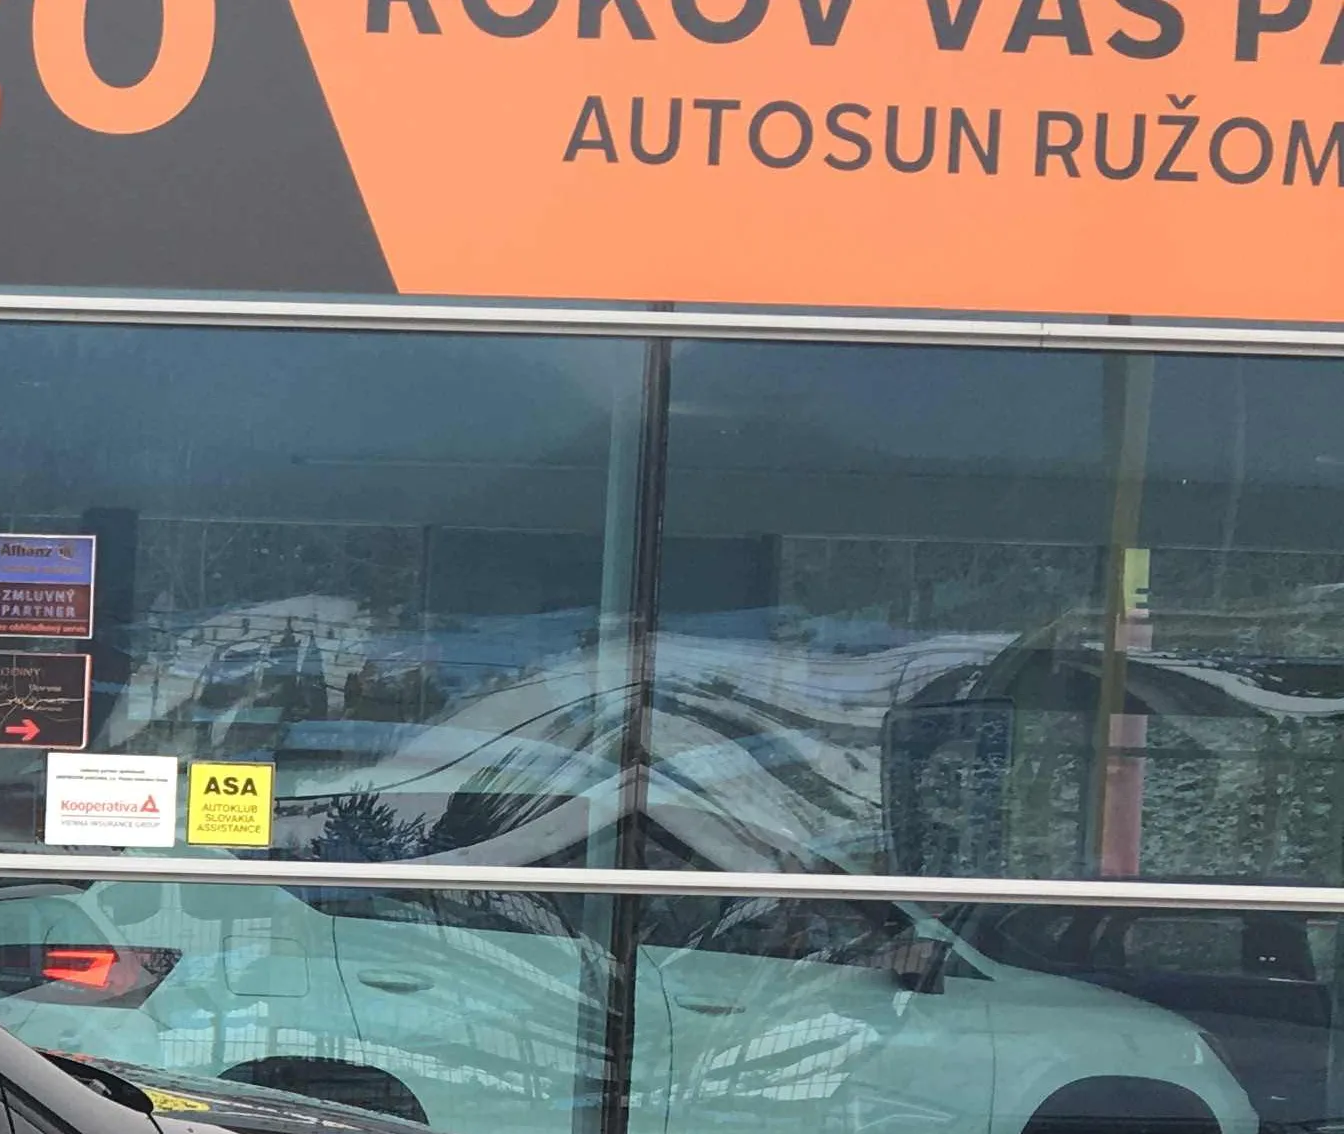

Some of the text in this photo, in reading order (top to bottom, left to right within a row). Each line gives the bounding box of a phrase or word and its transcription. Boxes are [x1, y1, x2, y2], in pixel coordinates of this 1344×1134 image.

[563, 95, 1002, 176] AUTOSUN
[1, 589, 75, 603] ZMLUVNÝ
[1, 605, 76, 618] PARTNER
[203, 776, 258, 797] ASA
[60, 800, 138, 814] Kooperativa
[201, 803, 258, 813] AUTOKLUB
[204, 813, 256, 823] SLOVAKIA
[196, 823, 262, 834] ASSISTANCE
